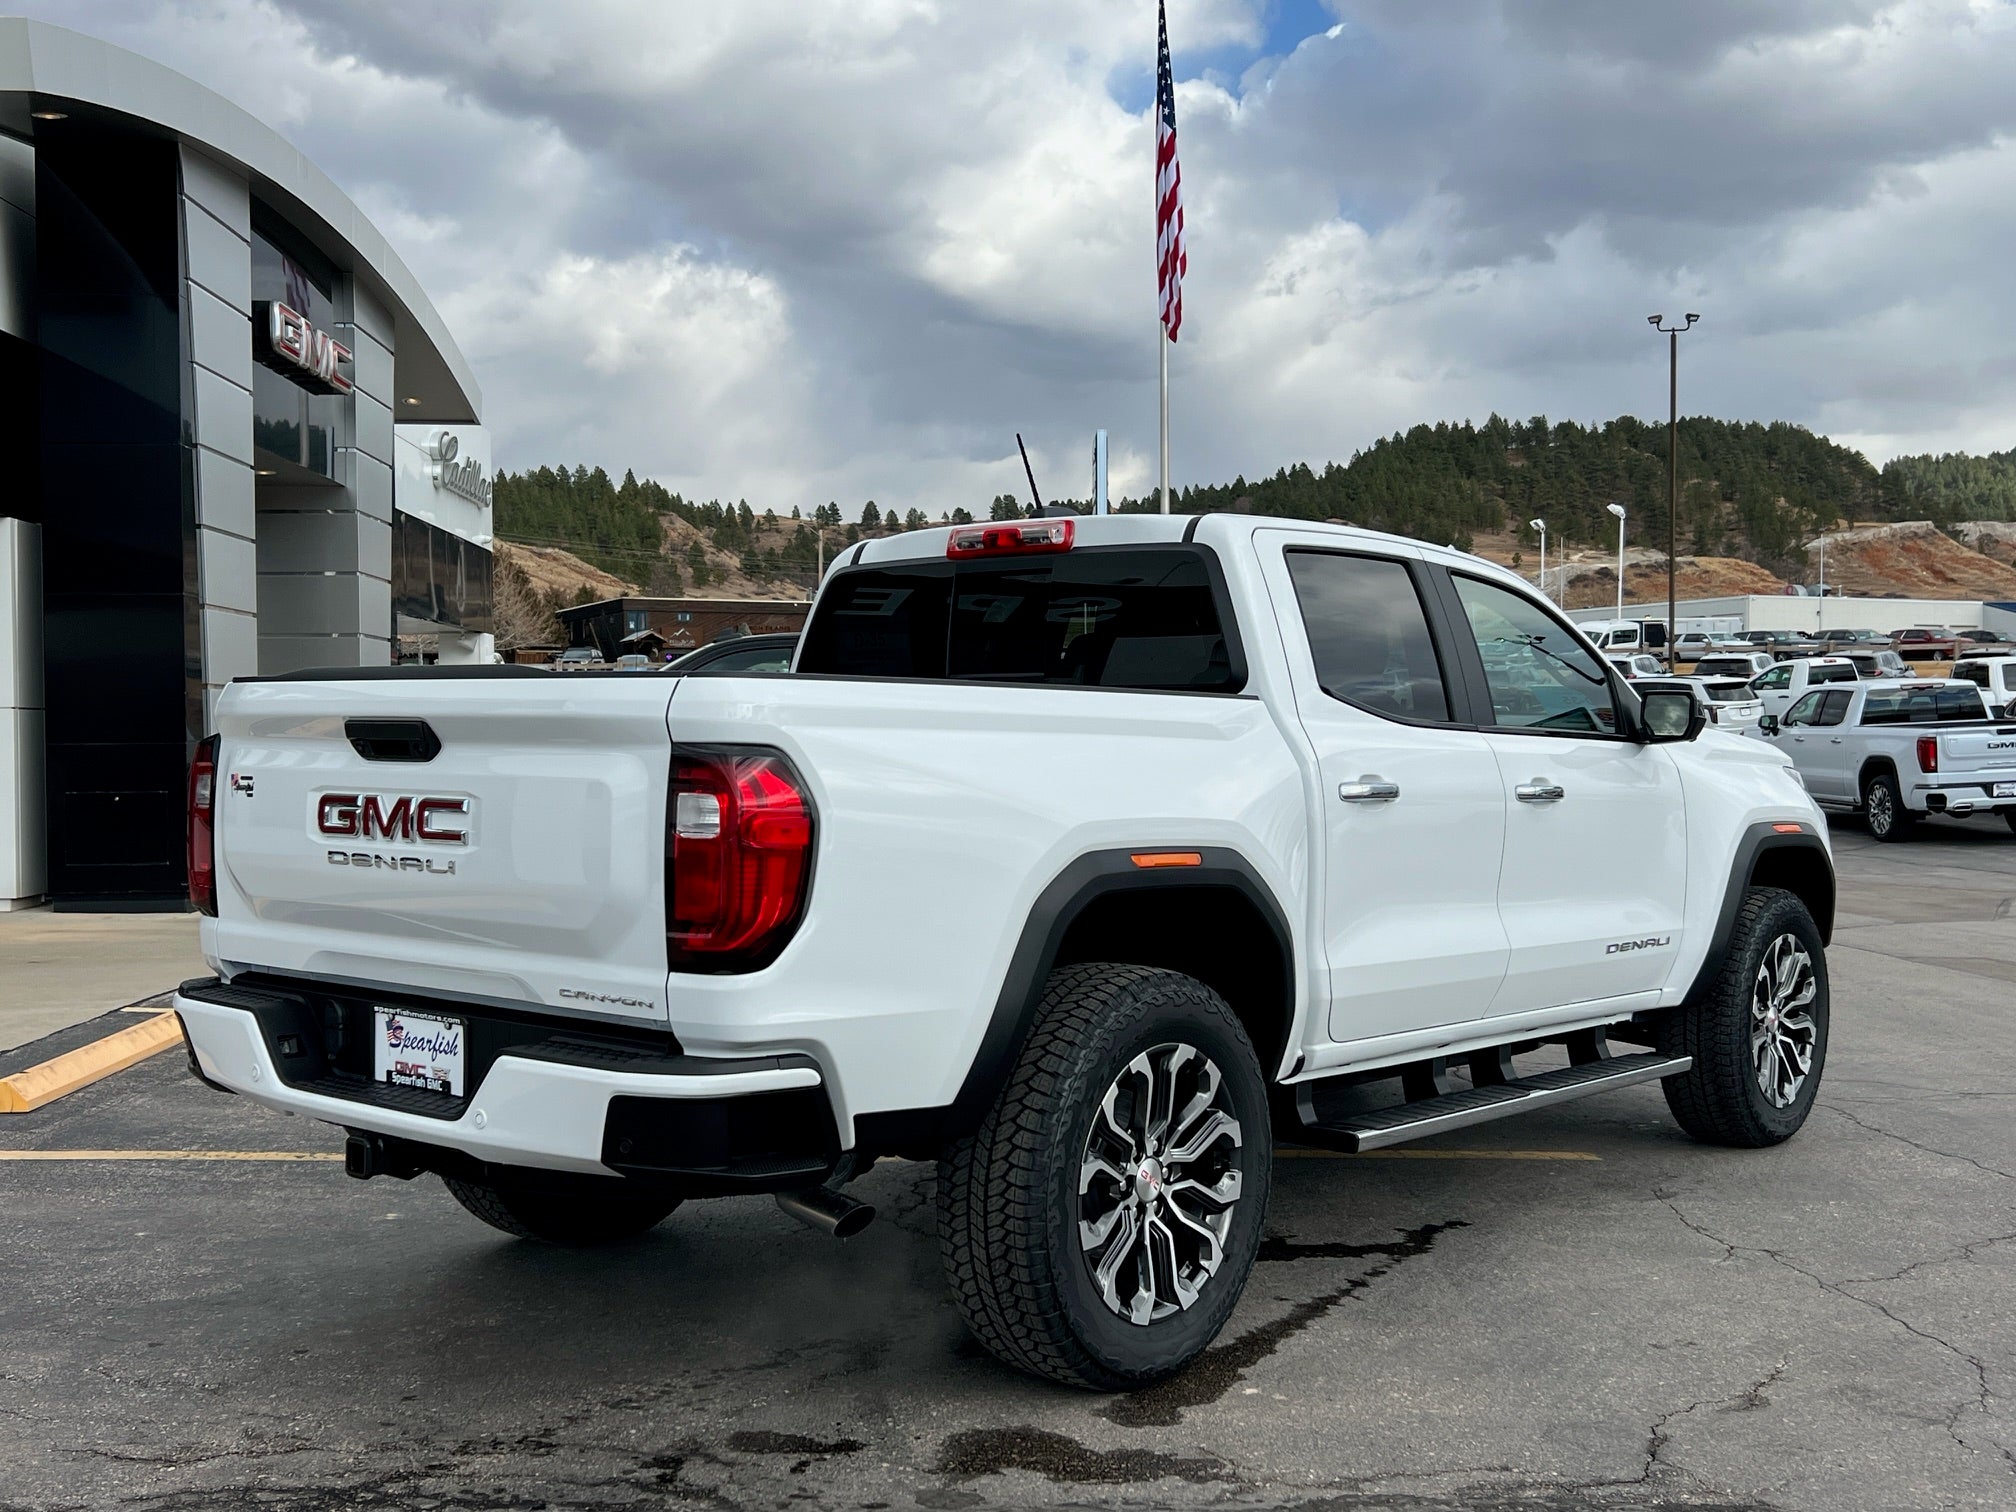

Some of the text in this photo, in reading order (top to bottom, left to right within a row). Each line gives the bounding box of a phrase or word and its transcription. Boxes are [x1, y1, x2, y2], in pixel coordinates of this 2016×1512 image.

[270, 301, 354, 395] GMC
[432, 430, 491, 508] Cadillac
[318, 793, 470, 846] GMC
[327, 850, 456, 875] DENALI
[1605, 935, 1670, 955] DENALI
[559, 988, 655, 1009] CANYON
[373, 1005, 461, 1025] spearfishmotors.com
[389, 1025, 460, 1062] Spearfish
[391, 1071, 426, 1088] Spearfish
[395, 1060, 427, 1077] GMC
[1140, 1169, 1160, 1191] GMC
